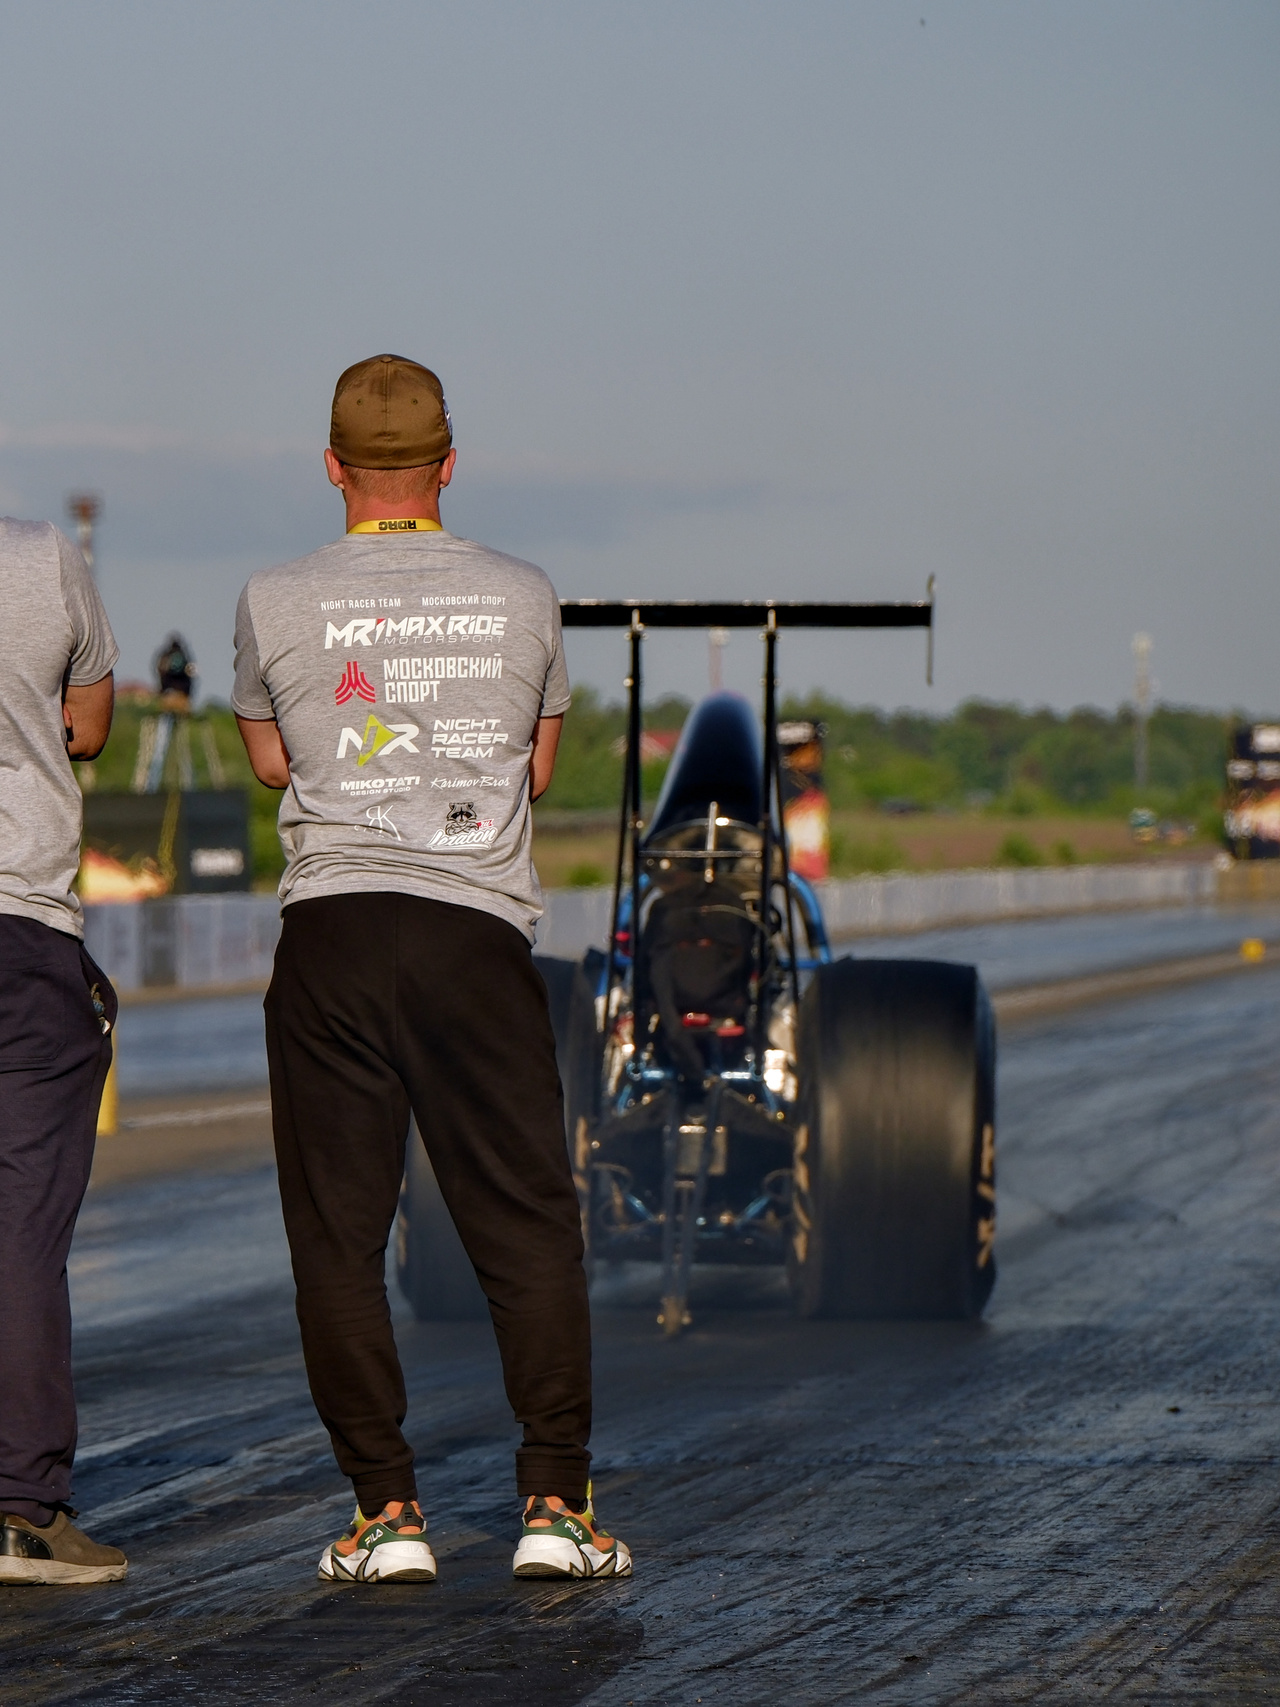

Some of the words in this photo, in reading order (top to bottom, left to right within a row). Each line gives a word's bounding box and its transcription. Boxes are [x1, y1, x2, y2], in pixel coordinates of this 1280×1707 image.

[378, 519, 418, 531] RDRC
[321, 600, 346, 611] NIGHT
[348, 598, 376, 609] RACER
[378, 598, 402, 608] TEAM
[421, 594, 479, 606] МОСКОВСКИЙ
[481, 596, 507, 606] СПОРТ
[385, 616, 447, 638] MAX
[383, 635, 504, 645] MOTORSPORT
[383, 653, 503, 680] МОСКОВСКИЙ
[384, 681, 440, 703] СПОРТ
[433, 718, 501, 731] NIGHT
[431, 732, 509, 746] RACER
[430, 746, 495, 759] TEAM
[340, 776, 421, 791] MIKOTATI
[430, 777, 477, 791] Karimov
[479, 776, 511, 788] Bros
[350, 788, 381, 796] DESIGN
[383, 786, 411, 794] STUDIO
[564, 1520, 584, 1540] FILA
[364, 1528, 384, 1548] FILA
